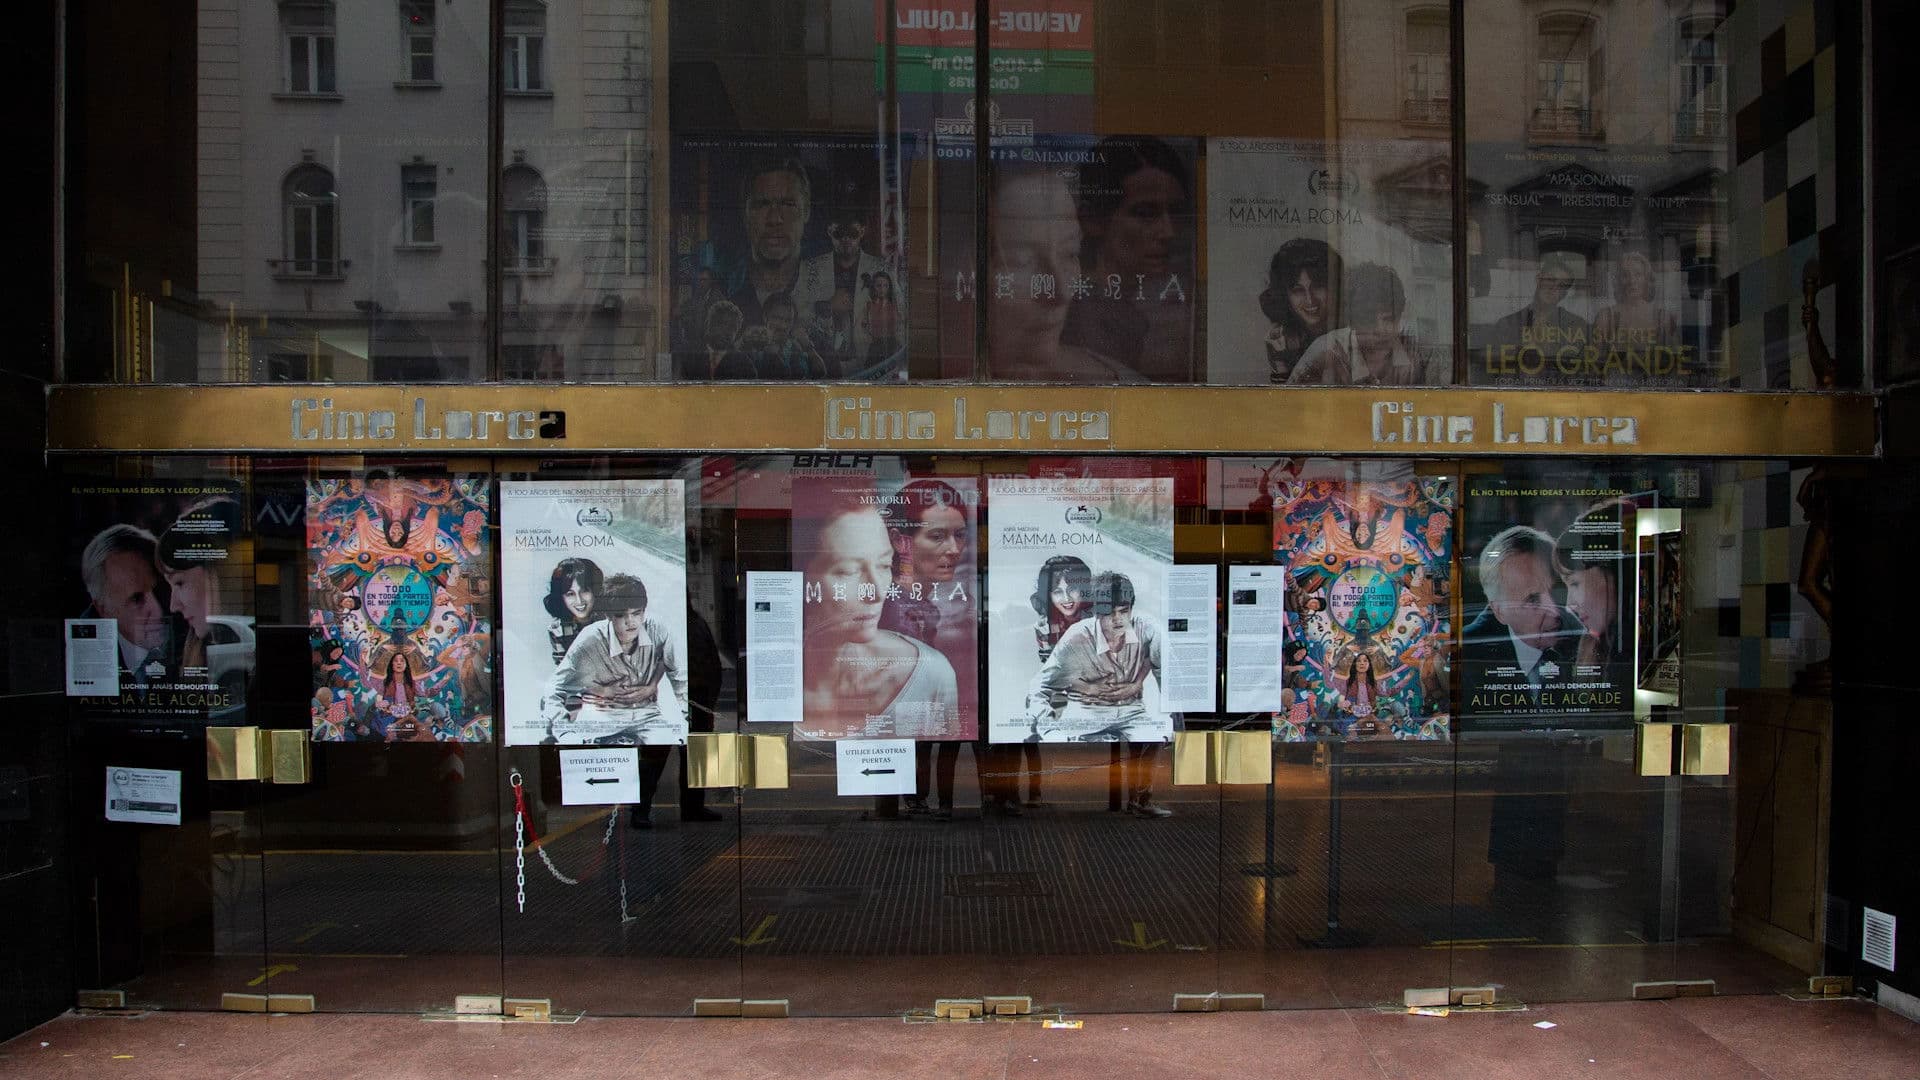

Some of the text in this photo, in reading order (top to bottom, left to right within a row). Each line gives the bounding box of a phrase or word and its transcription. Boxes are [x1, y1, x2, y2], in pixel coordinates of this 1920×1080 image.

[1032, 150, 1106, 163] MEMORIA
[1229, 207, 1364, 225] MAMMA ROMA
[1522, 327, 1657, 343] BUENA SUERTE
[1486, 344, 1697, 376] LEO GRANDE
[292, 397, 567, 440] Cine Lorca
[827, 397, 1109, 439] Cine Lorca
[1371, 401, 1638, 444] Cine Lorca
[793, 455, 873, 468] BALA
[859, 495, 911, 504] MEMORIA
[515, 535, 615, 547] MAMMA ROMA
[1002, 532, 1103, 545] MAMMA ROMA
[149, 694, 164, 705] EL
[170, 694, 230, 706] ALCALDE
[1541, 693, 1555, 705] EL
[1562, 692, 1622, 705] ALCALDE
